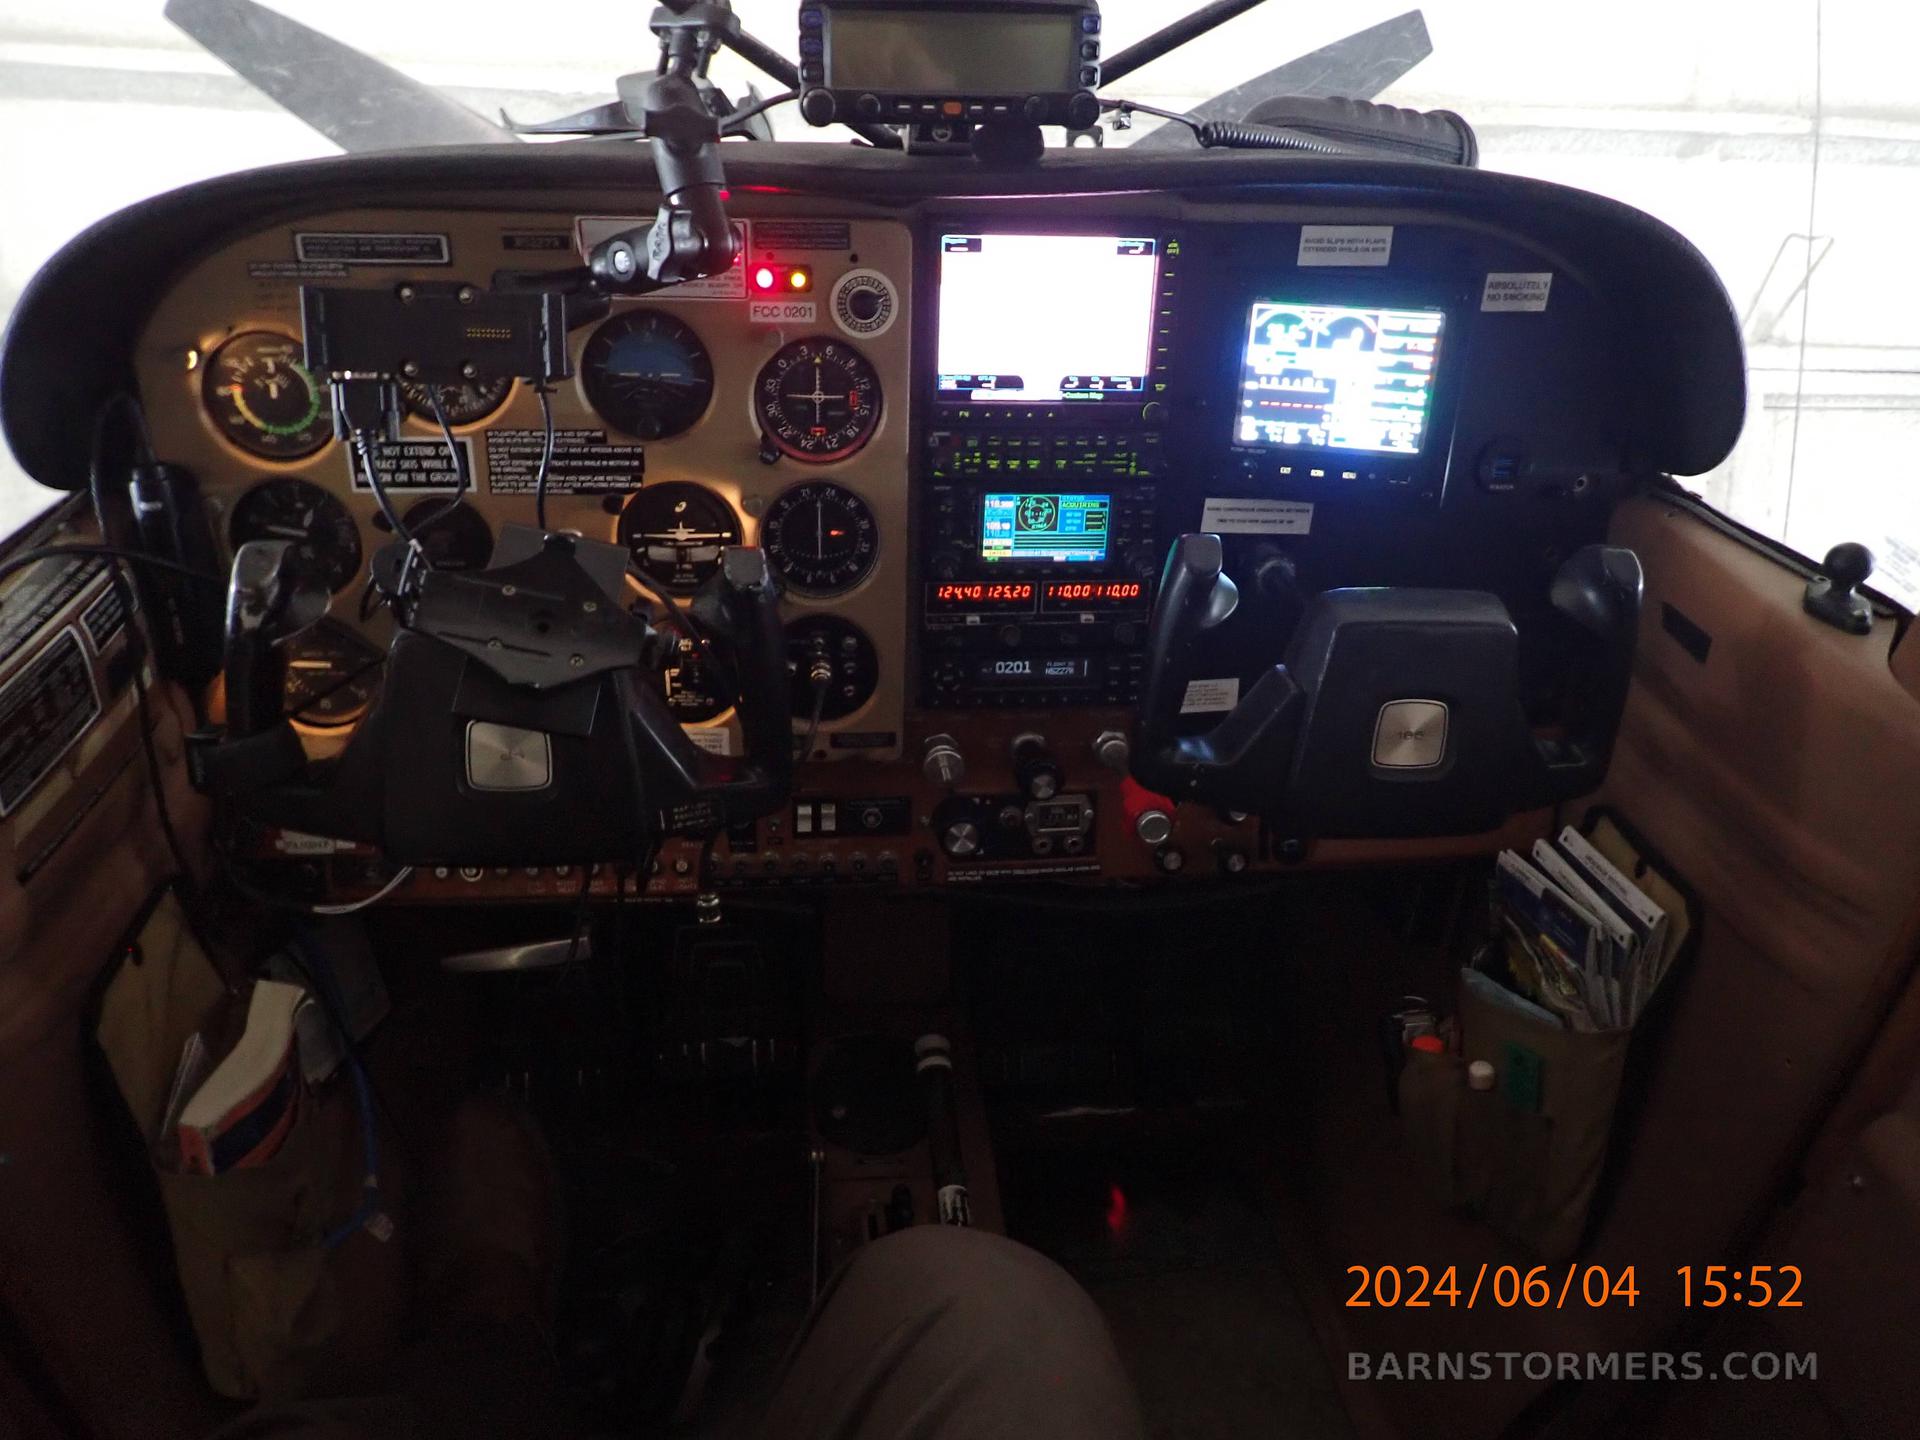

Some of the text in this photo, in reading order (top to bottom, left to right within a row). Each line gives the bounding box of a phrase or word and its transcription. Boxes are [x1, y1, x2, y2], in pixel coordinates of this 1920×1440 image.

[1488, 280, 1549, 290] ABSOLUTELY
[1486, 292, 1546, 302] NO SMOKING
[753, 306, 813, 318] FCC 0201
[995, 660, 1032, 674] 0201
